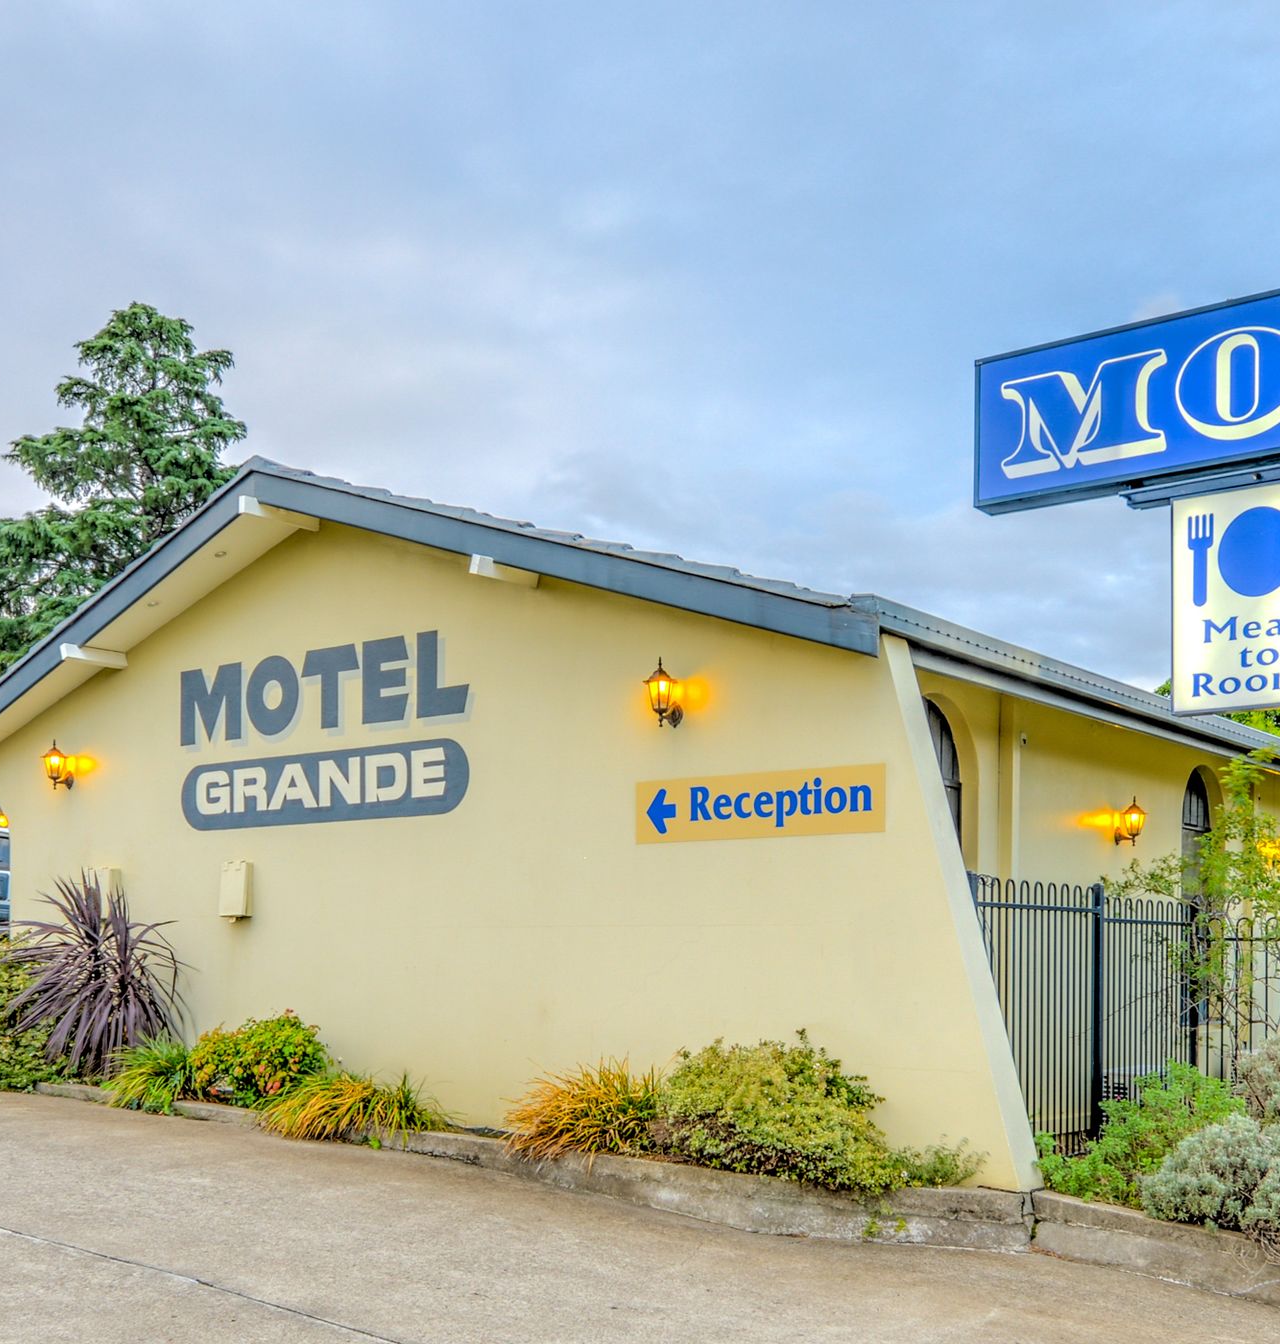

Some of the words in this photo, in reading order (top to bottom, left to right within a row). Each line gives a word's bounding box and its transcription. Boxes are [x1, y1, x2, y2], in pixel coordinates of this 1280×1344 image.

[1239, 646, 1280, 668] to
[180, 629, 470, 750] MOTEL
[194, 746, 448, 817] GRANDE
[688, 776, 873, 828] Reception
